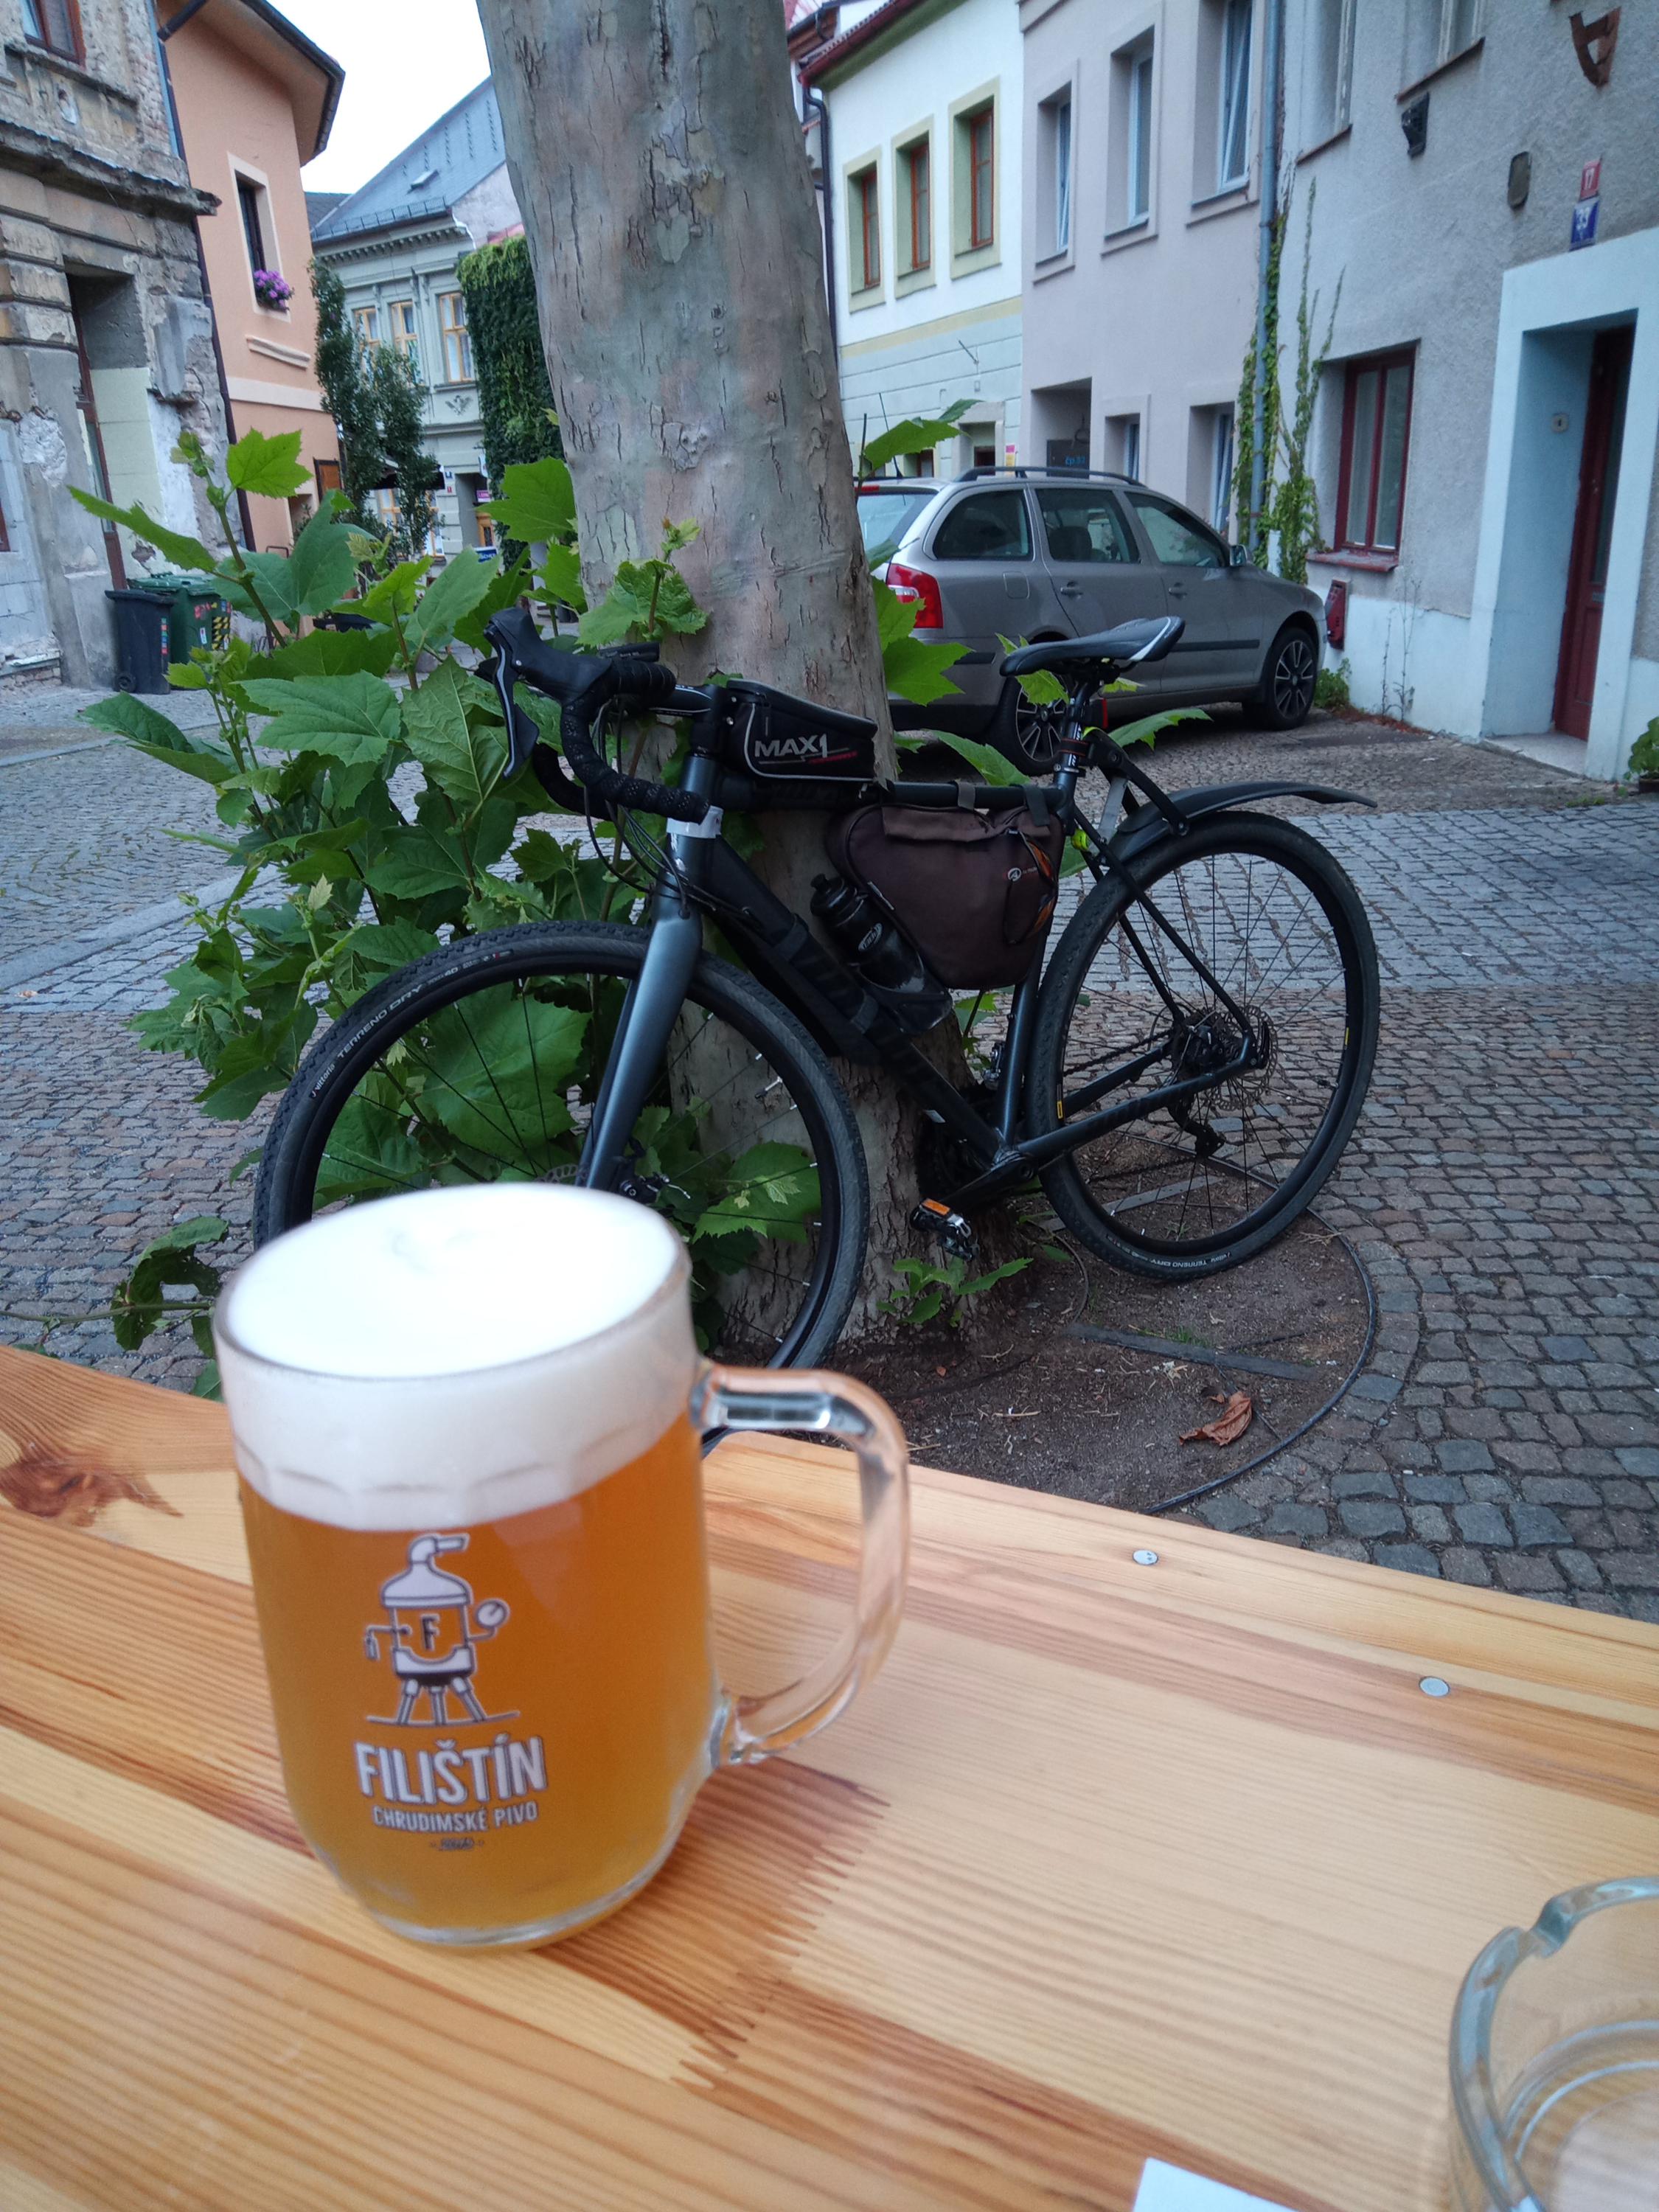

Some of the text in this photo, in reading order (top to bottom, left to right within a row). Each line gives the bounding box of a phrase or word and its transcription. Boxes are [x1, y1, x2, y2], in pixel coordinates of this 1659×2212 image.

[754, 734, 827, 759] MAX1
[337, 1009, 387, 1059] TERRENO
[389, 984, 422, 1010] DRY
[421, 1615, 440, 1651] F
[354, 1733, 548, 1805] FILIŠTÍN
[494, 1800, 538, 1828] PIVO
